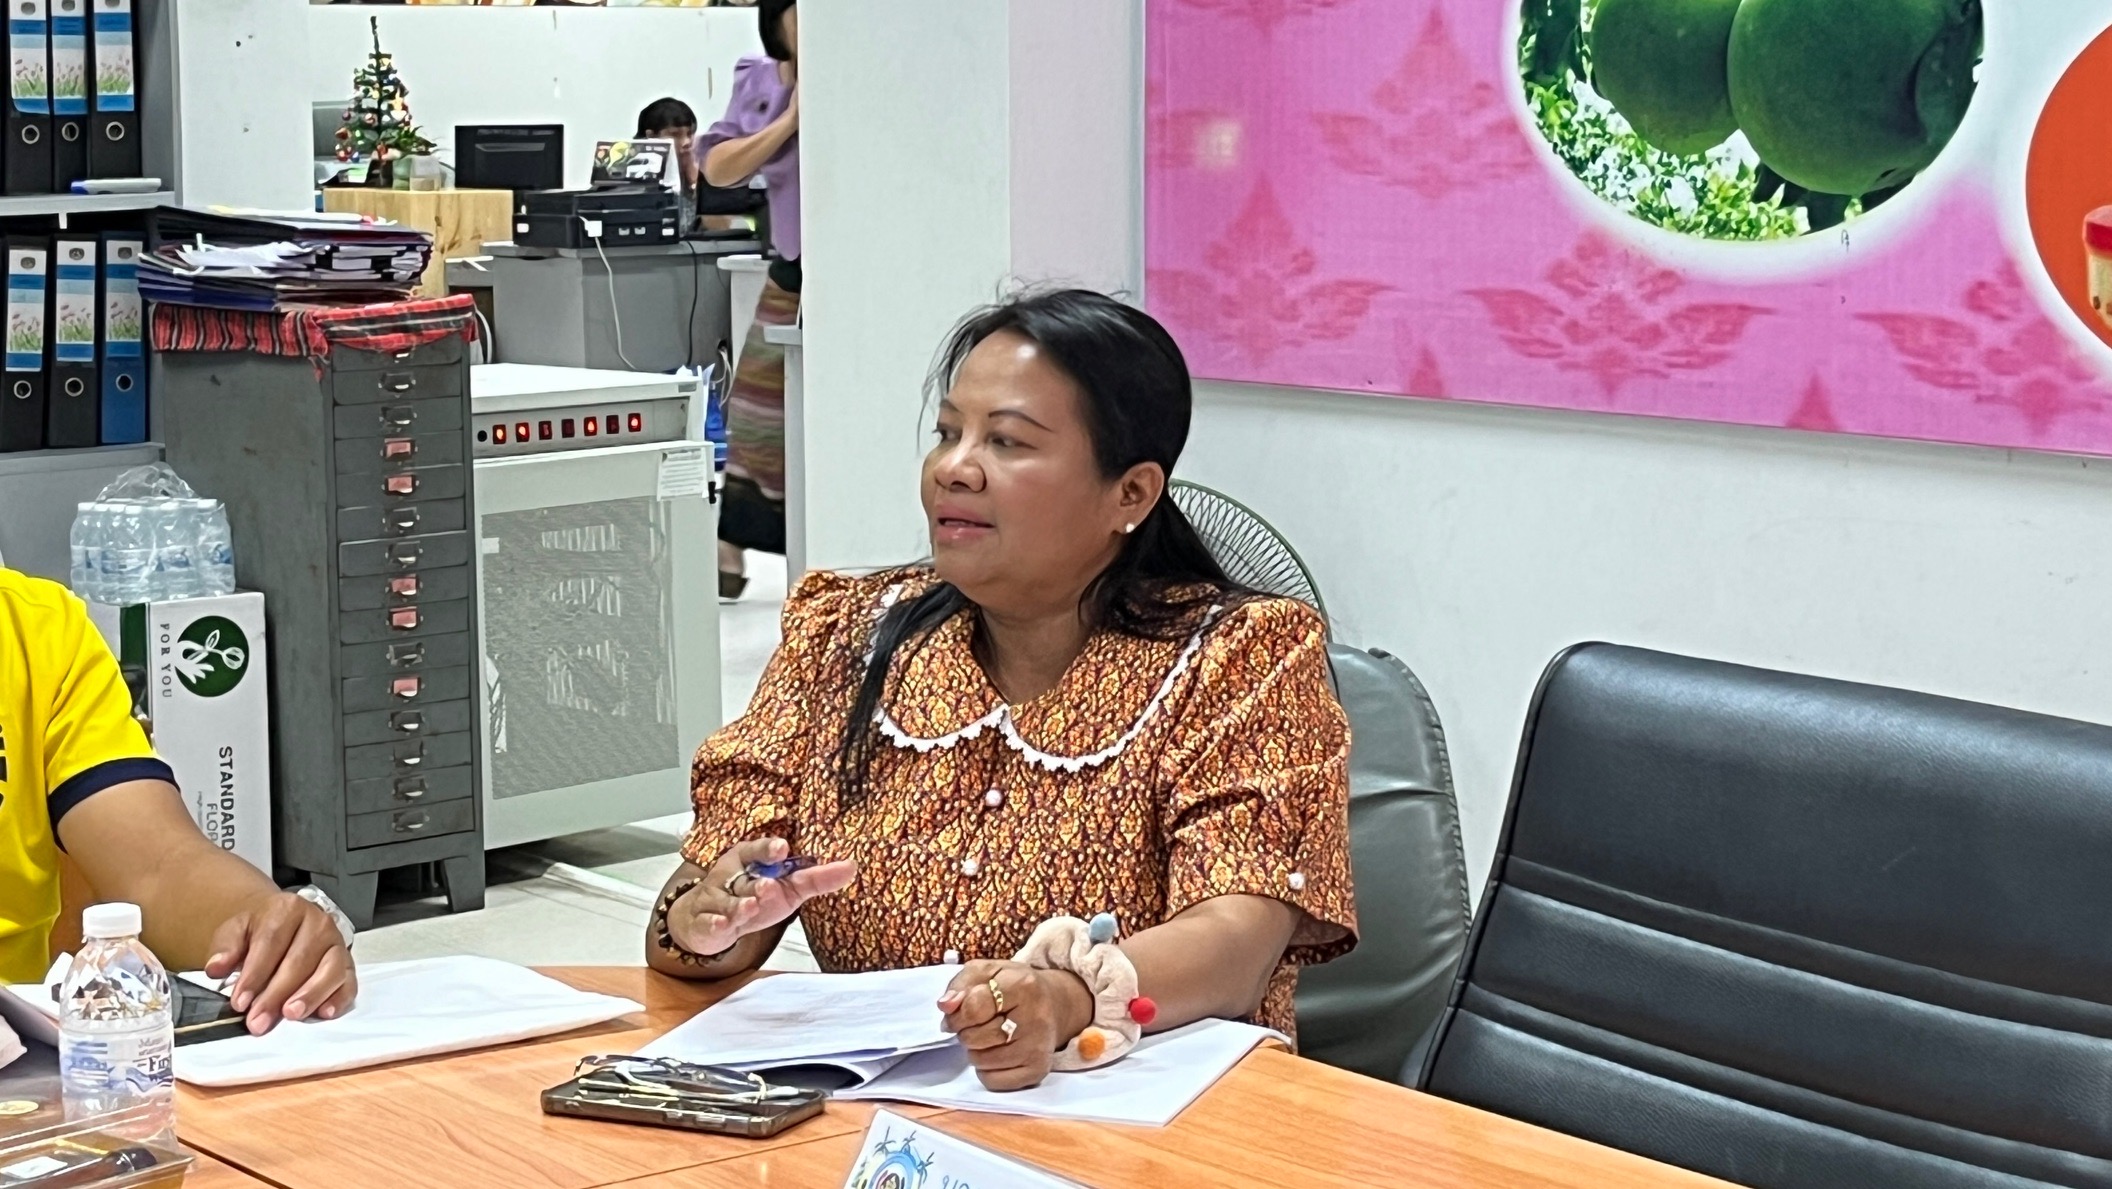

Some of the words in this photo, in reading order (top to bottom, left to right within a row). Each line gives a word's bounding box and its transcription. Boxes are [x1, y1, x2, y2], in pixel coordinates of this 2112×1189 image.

[160, 623, 171, 656] FOR
[161, 663, 172, 698] YOU
[219, 746, 235, 851] STANDARD
